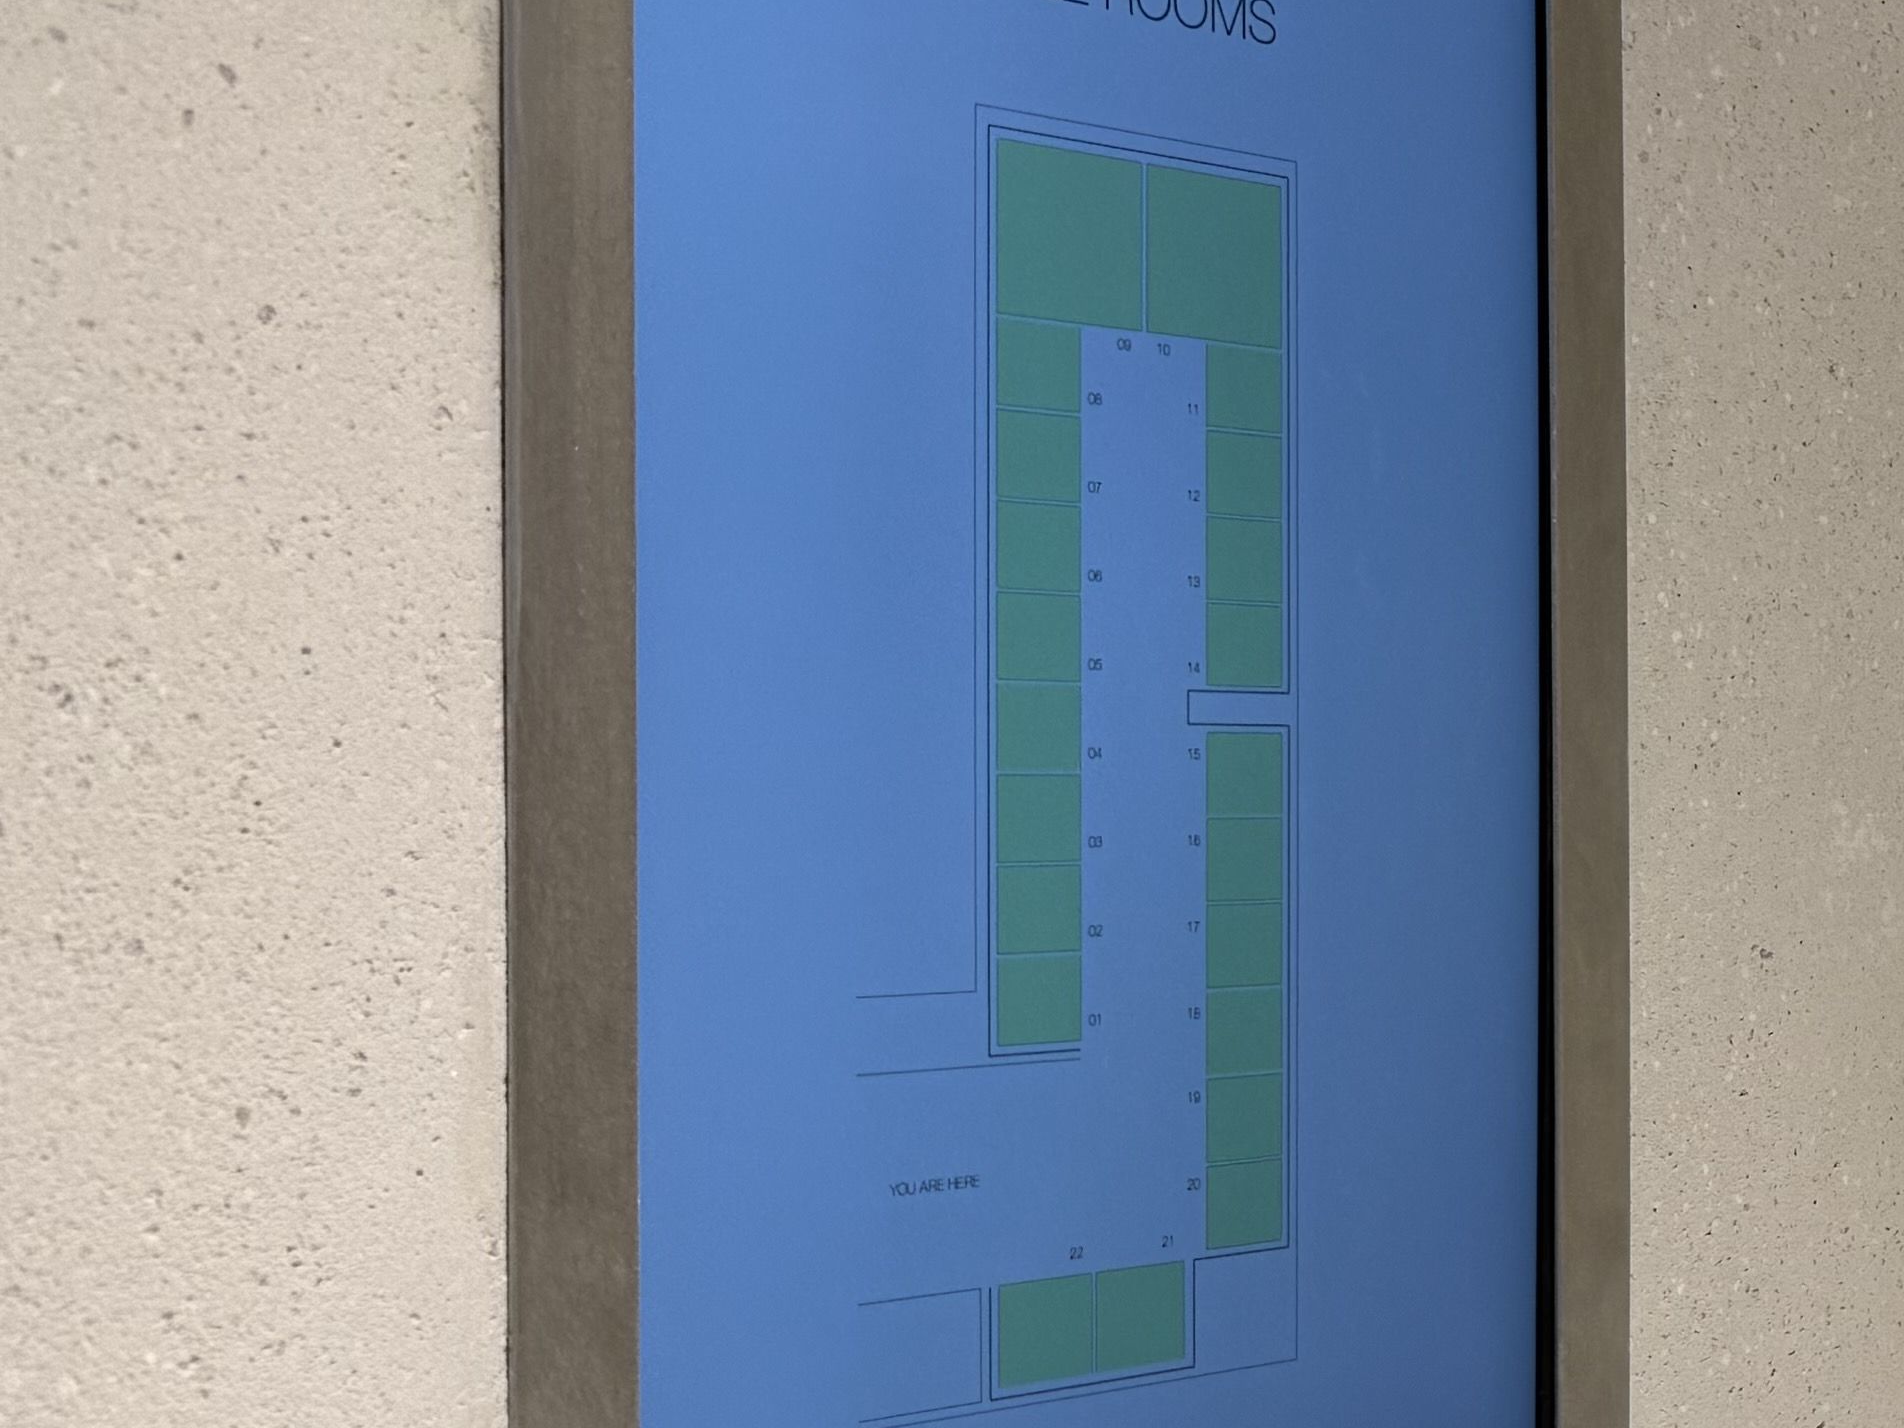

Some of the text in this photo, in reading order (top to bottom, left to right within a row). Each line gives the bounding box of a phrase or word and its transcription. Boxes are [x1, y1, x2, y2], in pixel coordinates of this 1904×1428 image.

[1156, 342, 1171, 357] 10
[1187, 402, 1199, 415] 11
[1086, 480, 1103, 494] 07
[1187, 489, 1201, 503] 12
[1086, 657, 1103, 671] 05
[1086, 923, 1104, 938] 02
[1187, 920, 1201, 933] 17
[1086, 1013, 1103, 1027] 01
[1187, 1089, 1202, 1105] 19
[888, 1174, 981, 1197] YOU ARE HERE
[1186, 1177, 1201, 1192] 20
[1161, 1235, 1174, 1249] 21
[1069, 1245, 1084, 1261] 22
